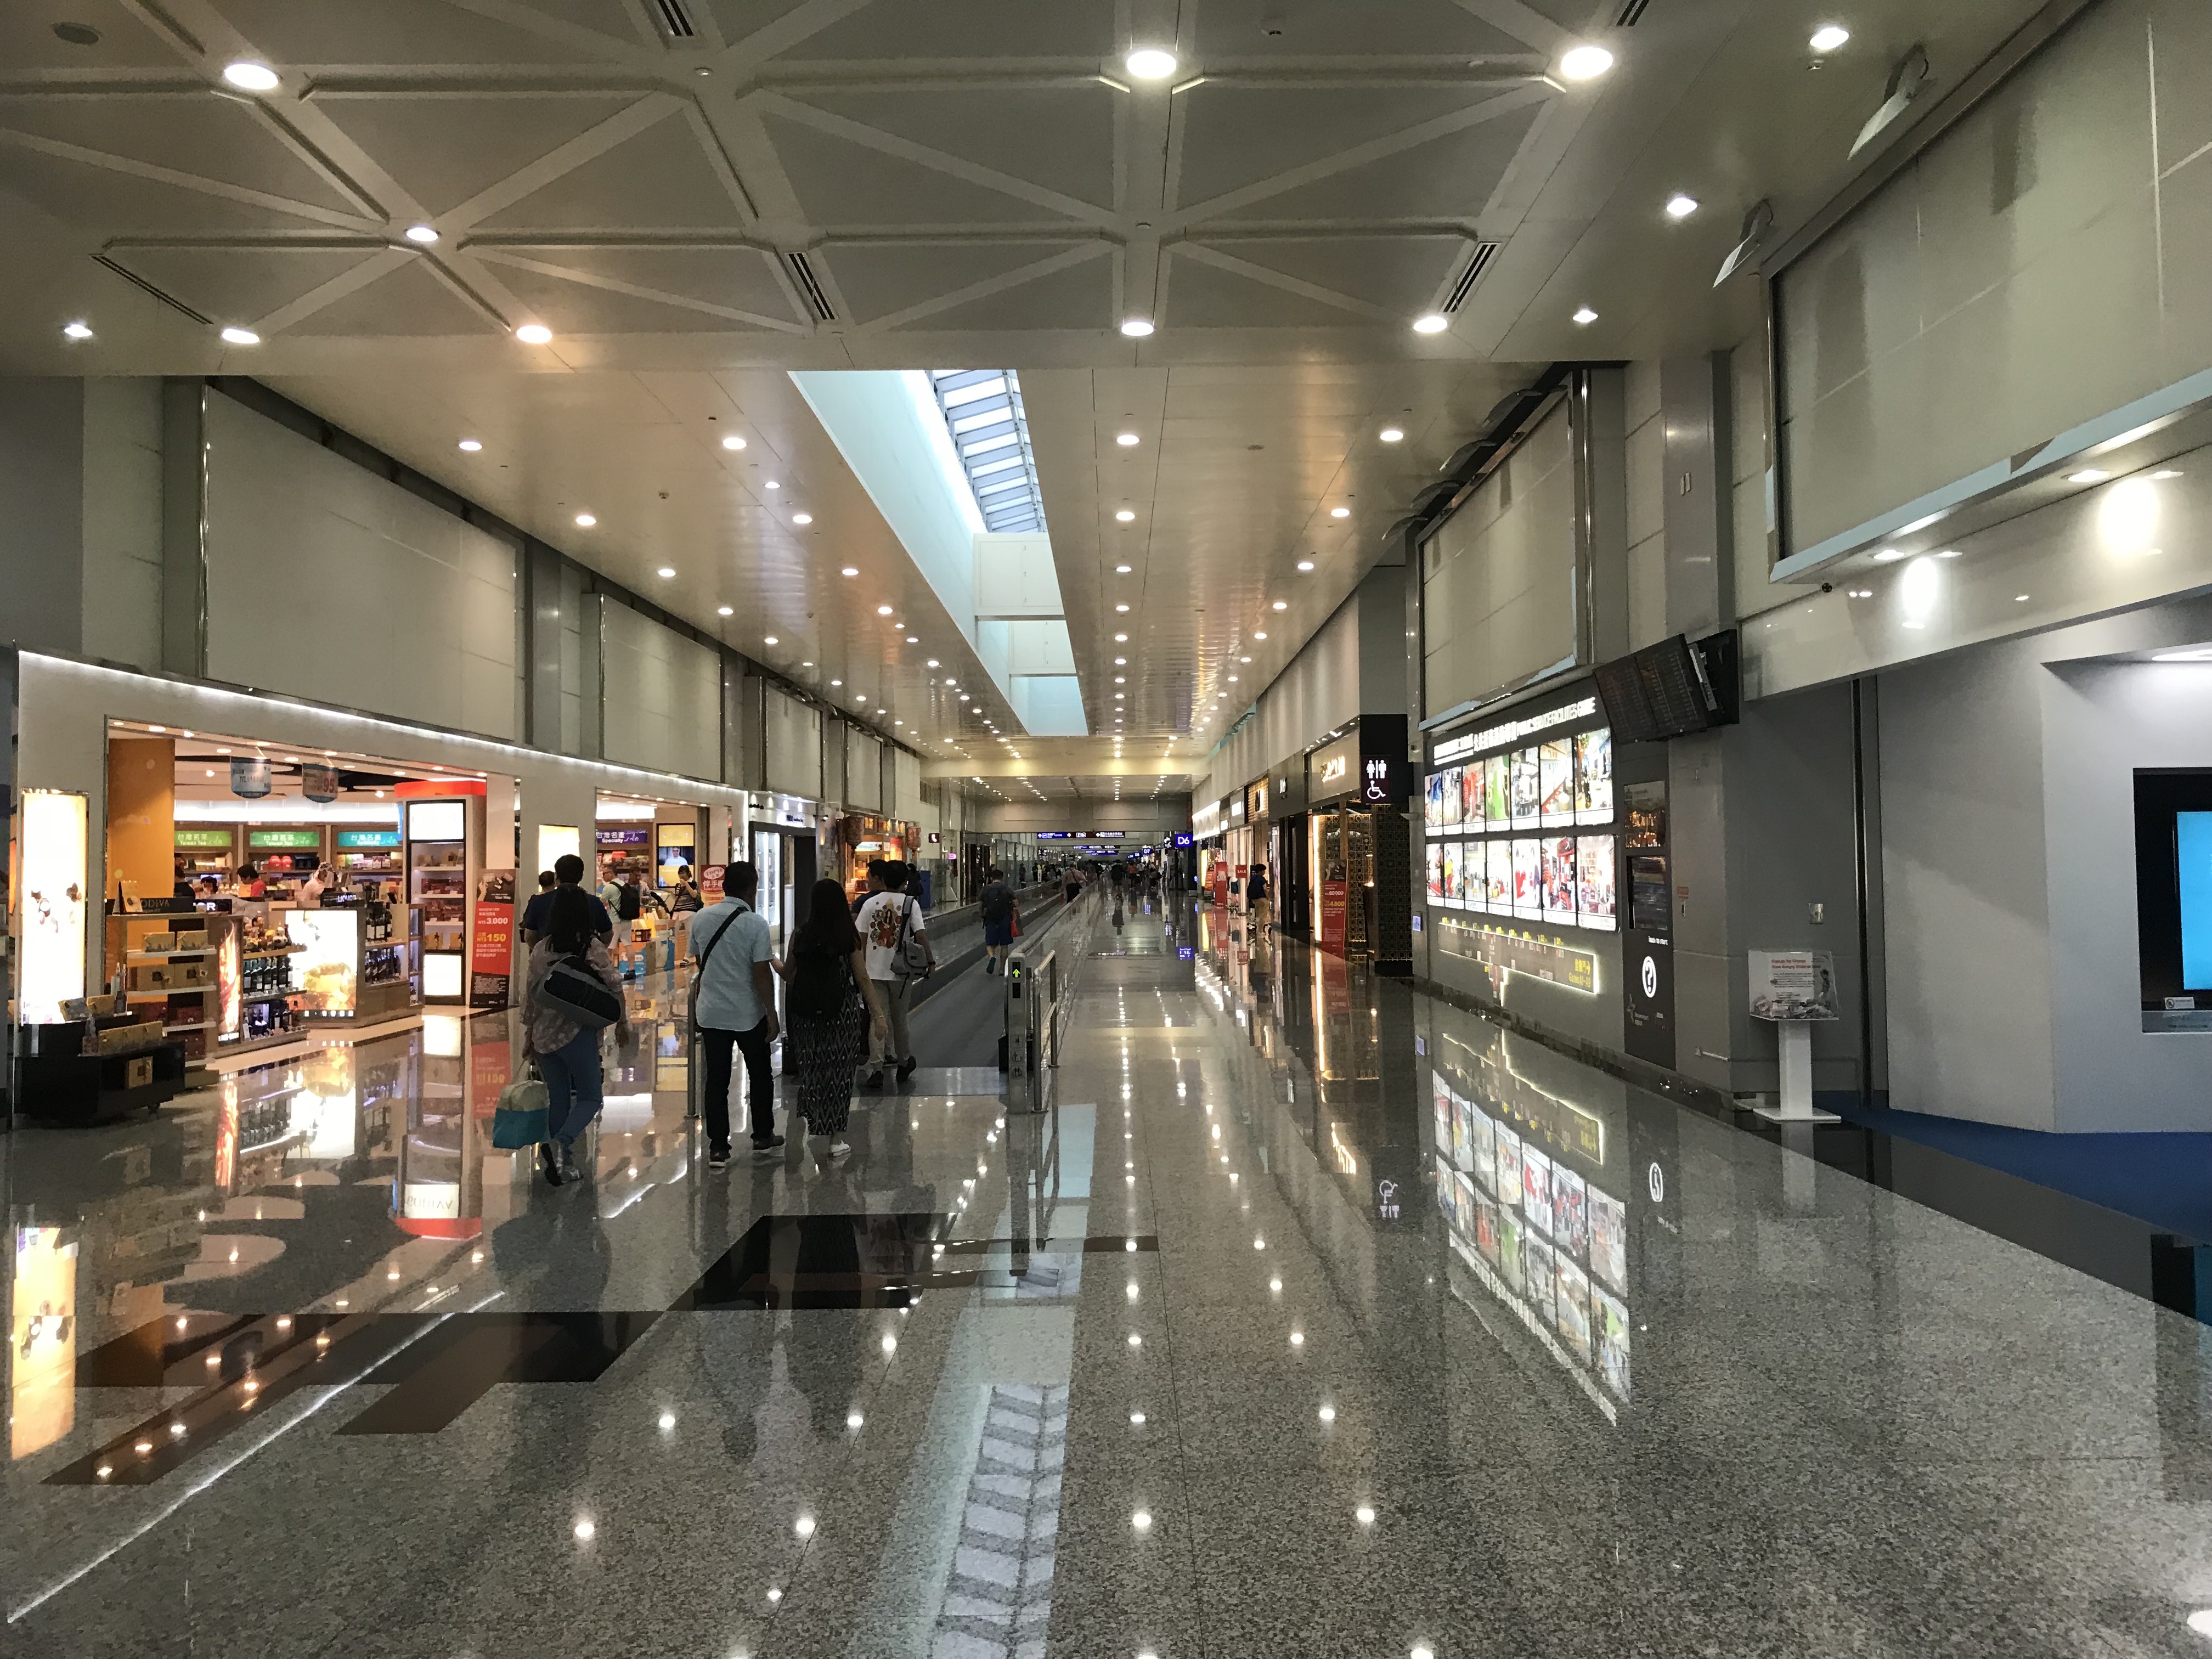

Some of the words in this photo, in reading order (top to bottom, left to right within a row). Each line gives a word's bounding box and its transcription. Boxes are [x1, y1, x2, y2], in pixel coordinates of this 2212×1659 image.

[1177, 837, 1190, 845] D6
[141, 899, 170, 908] ODIVA
[487, 933, 506, 942] 150
